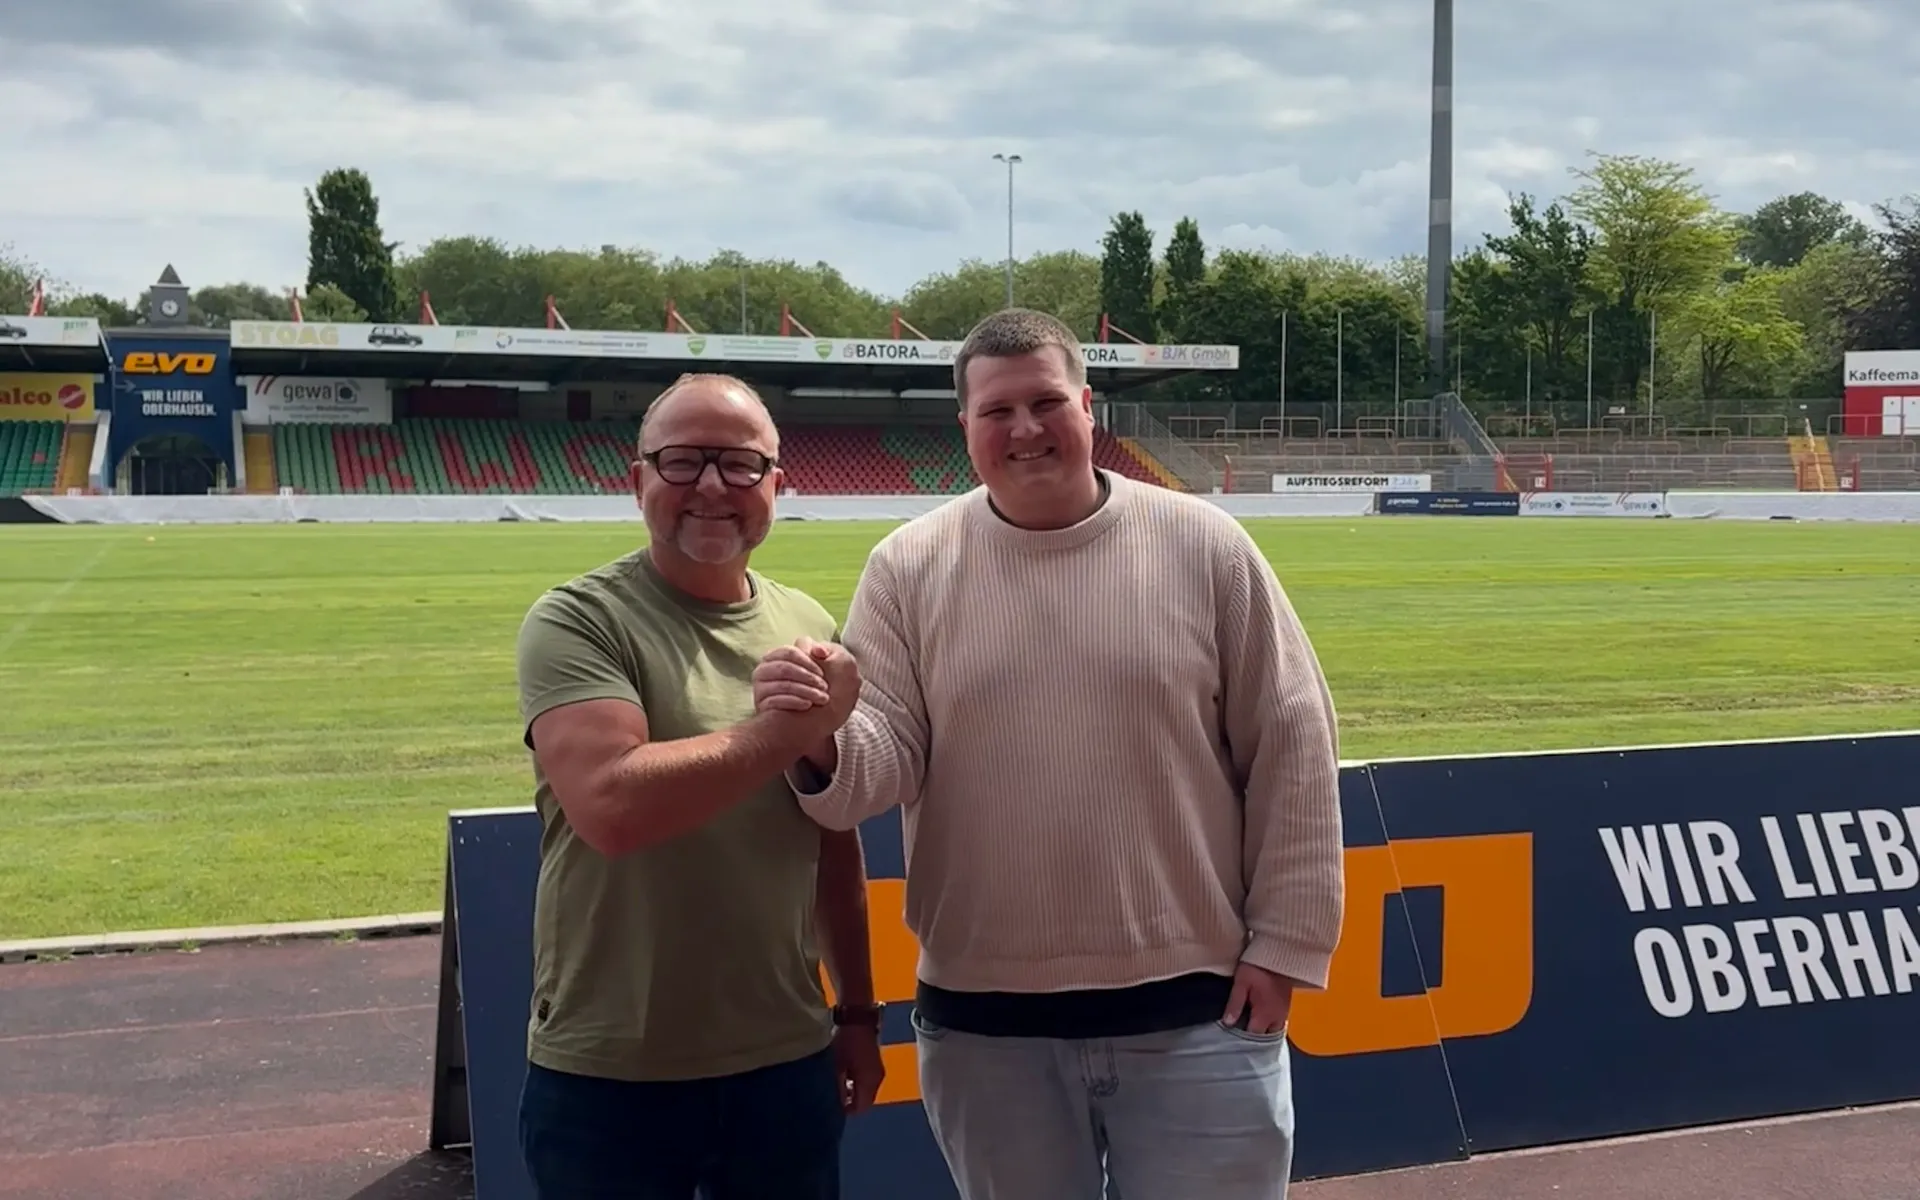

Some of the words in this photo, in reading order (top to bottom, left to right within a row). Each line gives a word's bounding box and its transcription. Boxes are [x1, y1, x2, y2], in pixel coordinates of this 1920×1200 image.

[239, 322, 339, 346] STOAG
[856, 344, 919, 360] BATORA
[1162, 346, 1188, 361] BJK
[1191, 347, 1230, 361] Gmbh
[123, 352, 217, 374] evo
[142, 389, 164, 402] WIR
[166, 390, 204, 403] LIEBEN
[283, 383, 332, 403] gewa
[1286, 476, 1389, 487] AUFSTIEGSREFORM
[1597, 820, 1757, 913] WIR
[1633, 907, 1920, 1019] OBERHA
